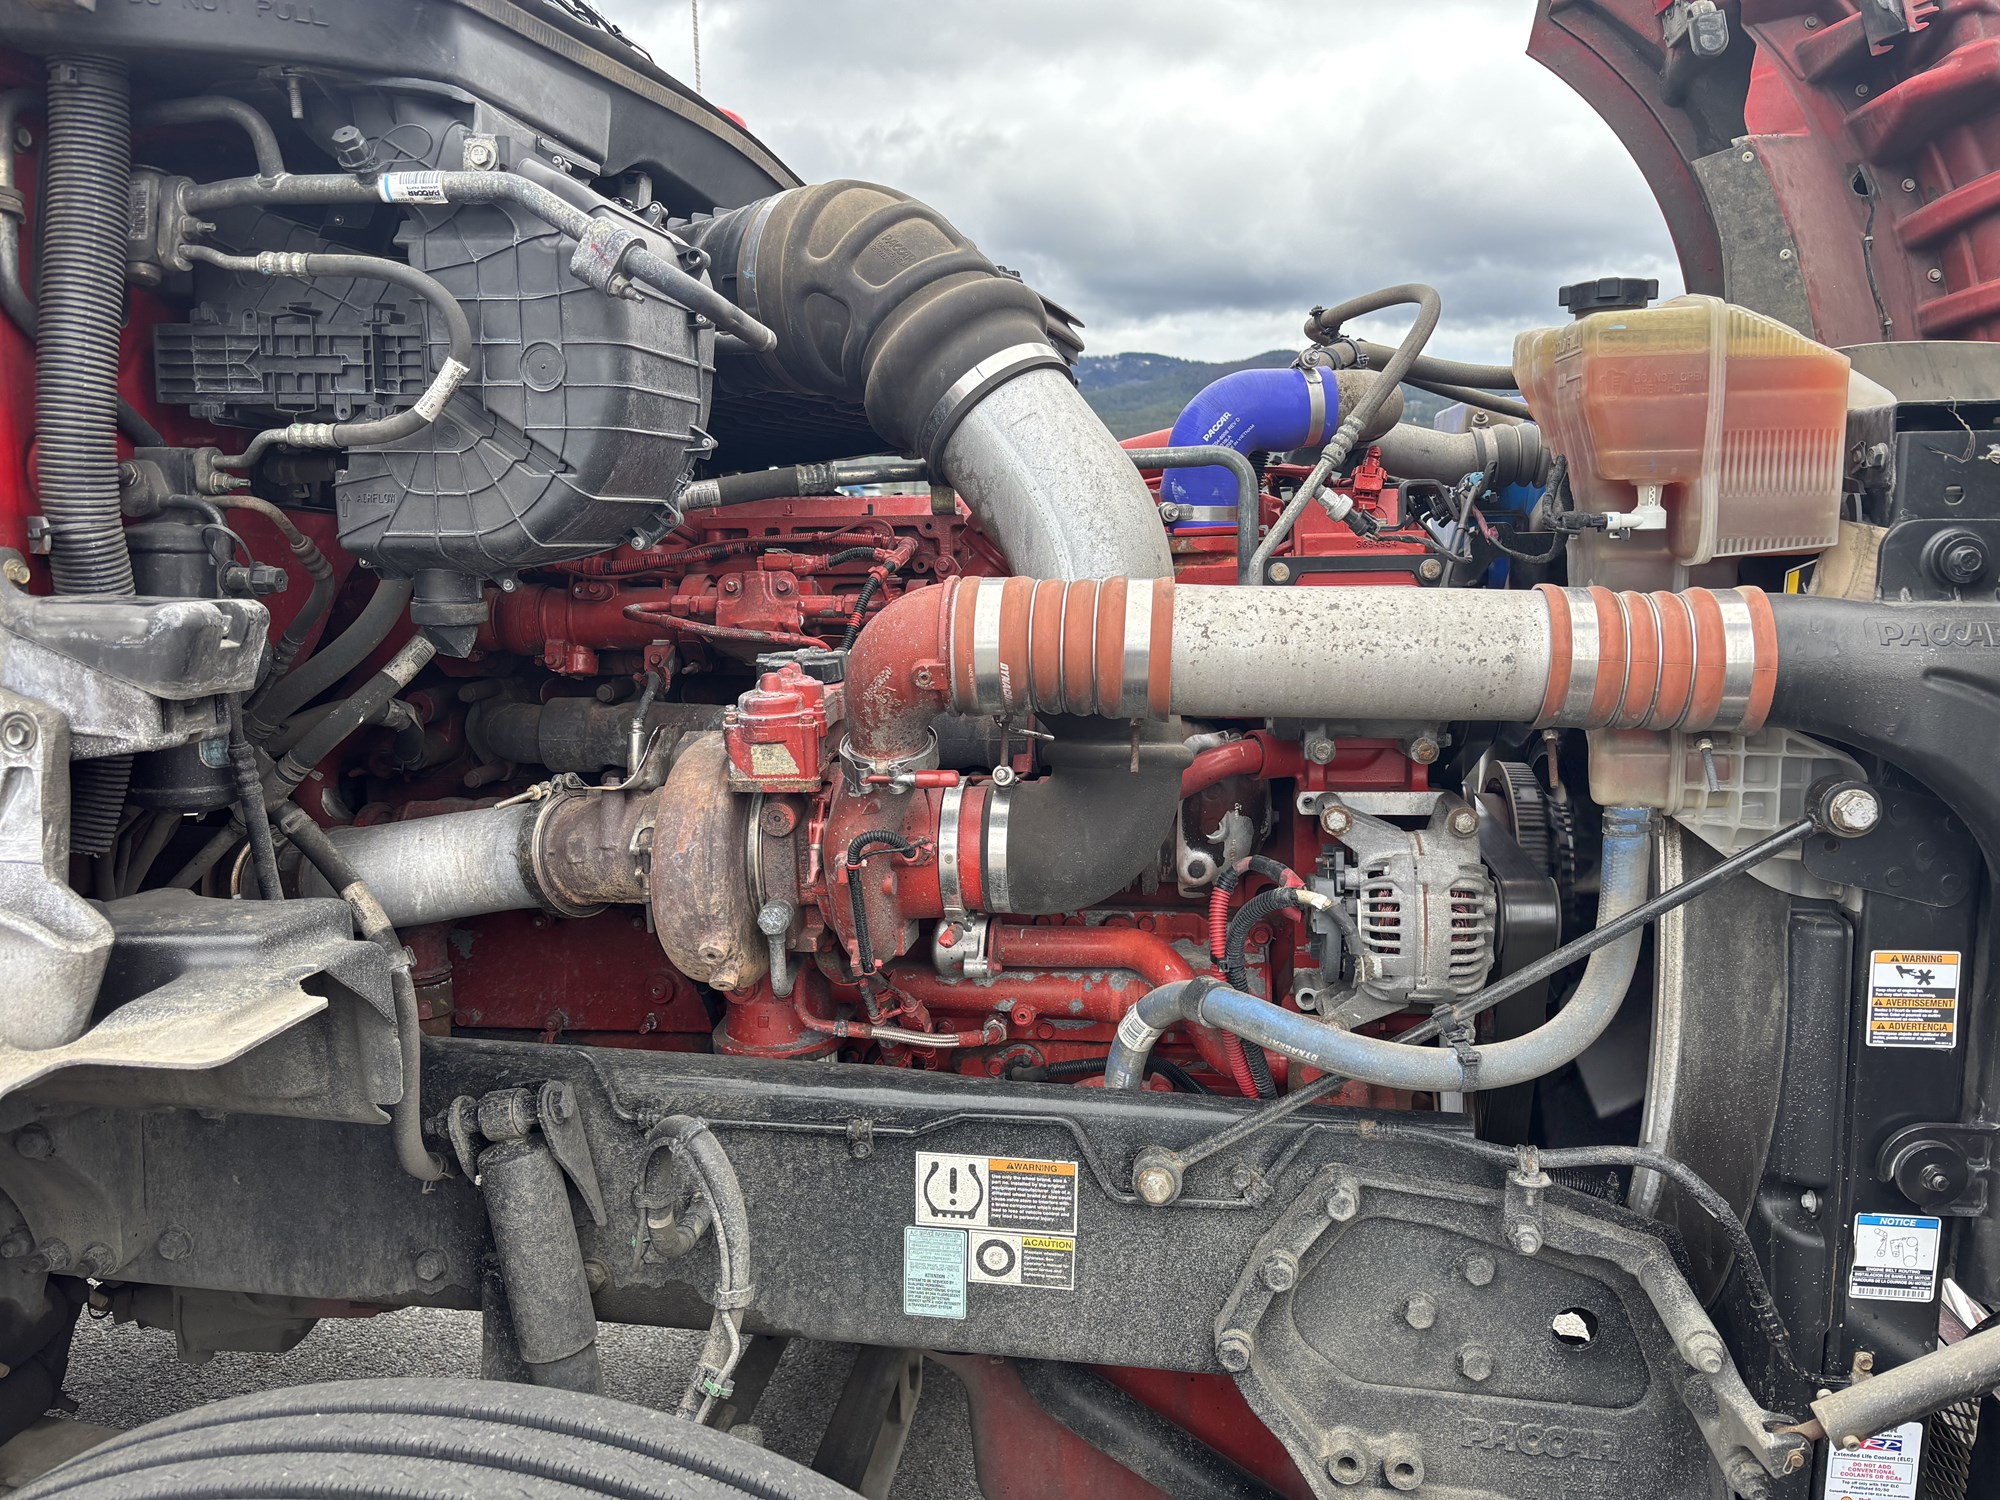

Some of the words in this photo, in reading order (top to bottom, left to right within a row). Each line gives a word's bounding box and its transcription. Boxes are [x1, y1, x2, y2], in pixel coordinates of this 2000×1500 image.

[256, 0, 329, 27] PULL
[1203, 411, 1232, 442] PACCAR
[357, 493, 396, 504] AIRFLOW
[1902, 955, 1943, 963] WARNING
[1886, 999, 1953, 1008] AVERTISSEMENT
[1889, 1023, 1948, 1031] ADVERTENCIA
[1014, 1163, 1058, 1172] WARNING
[1880, 1217, 1917, 1227] NOTICE
[1031, 1239, 1072, 1249] CAUTION
[1848, 1467, 1895, 1475] CONVENTIONAL
